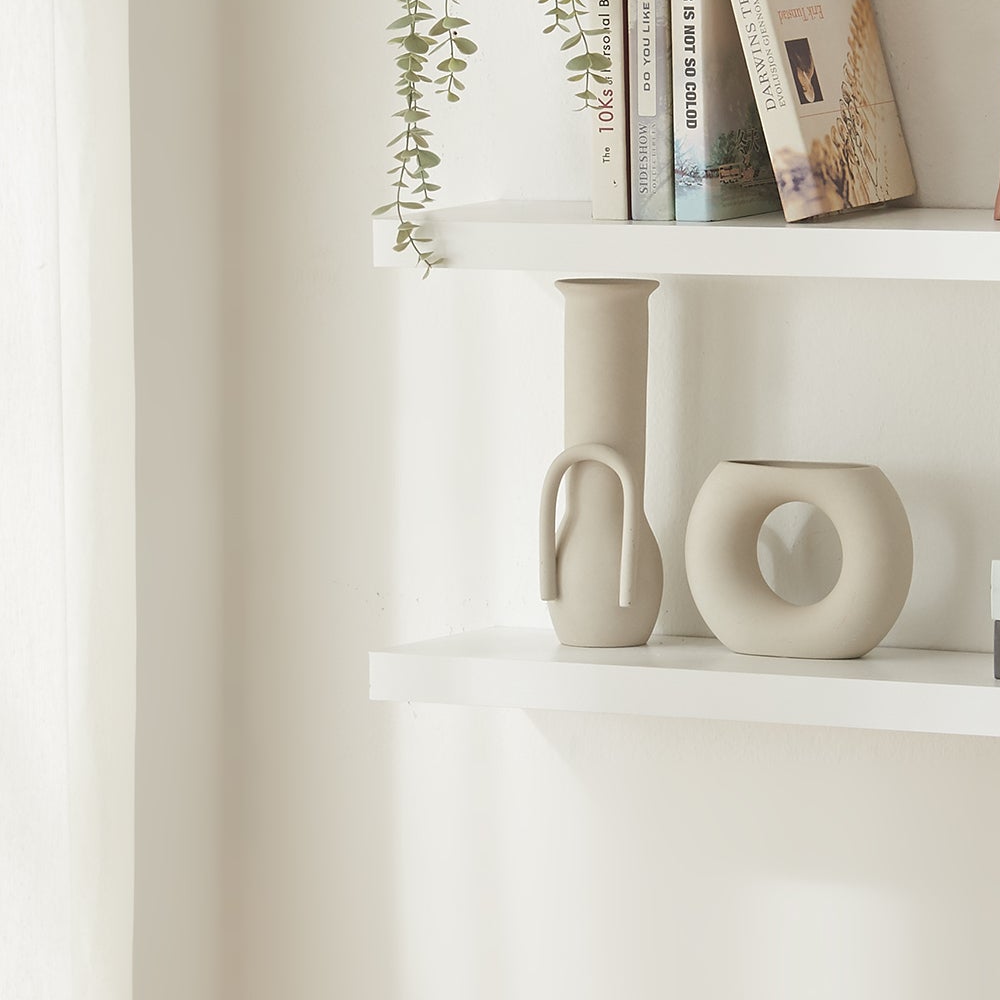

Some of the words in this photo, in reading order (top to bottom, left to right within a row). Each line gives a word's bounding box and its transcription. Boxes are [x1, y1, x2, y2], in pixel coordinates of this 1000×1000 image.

[683, 6, 695, 20] IS
[808, 5, 824, 20] Erik
[643, 38, 651, 66] YOU
[684, 25, 696, 53] NOT
[684, 58, 696, 77] SO
[745, 22, 777, 111] DARWINS
[763, 49, 786, 108] EVOLUSJON
[643, 71, 651, 91] DO
[598, 89, 614, 133] 10Ks
[685, 82, 697, 129] COLOD
[602, 147, 611, 163] The
[639, 123, 648, 194] SIDESHOW
